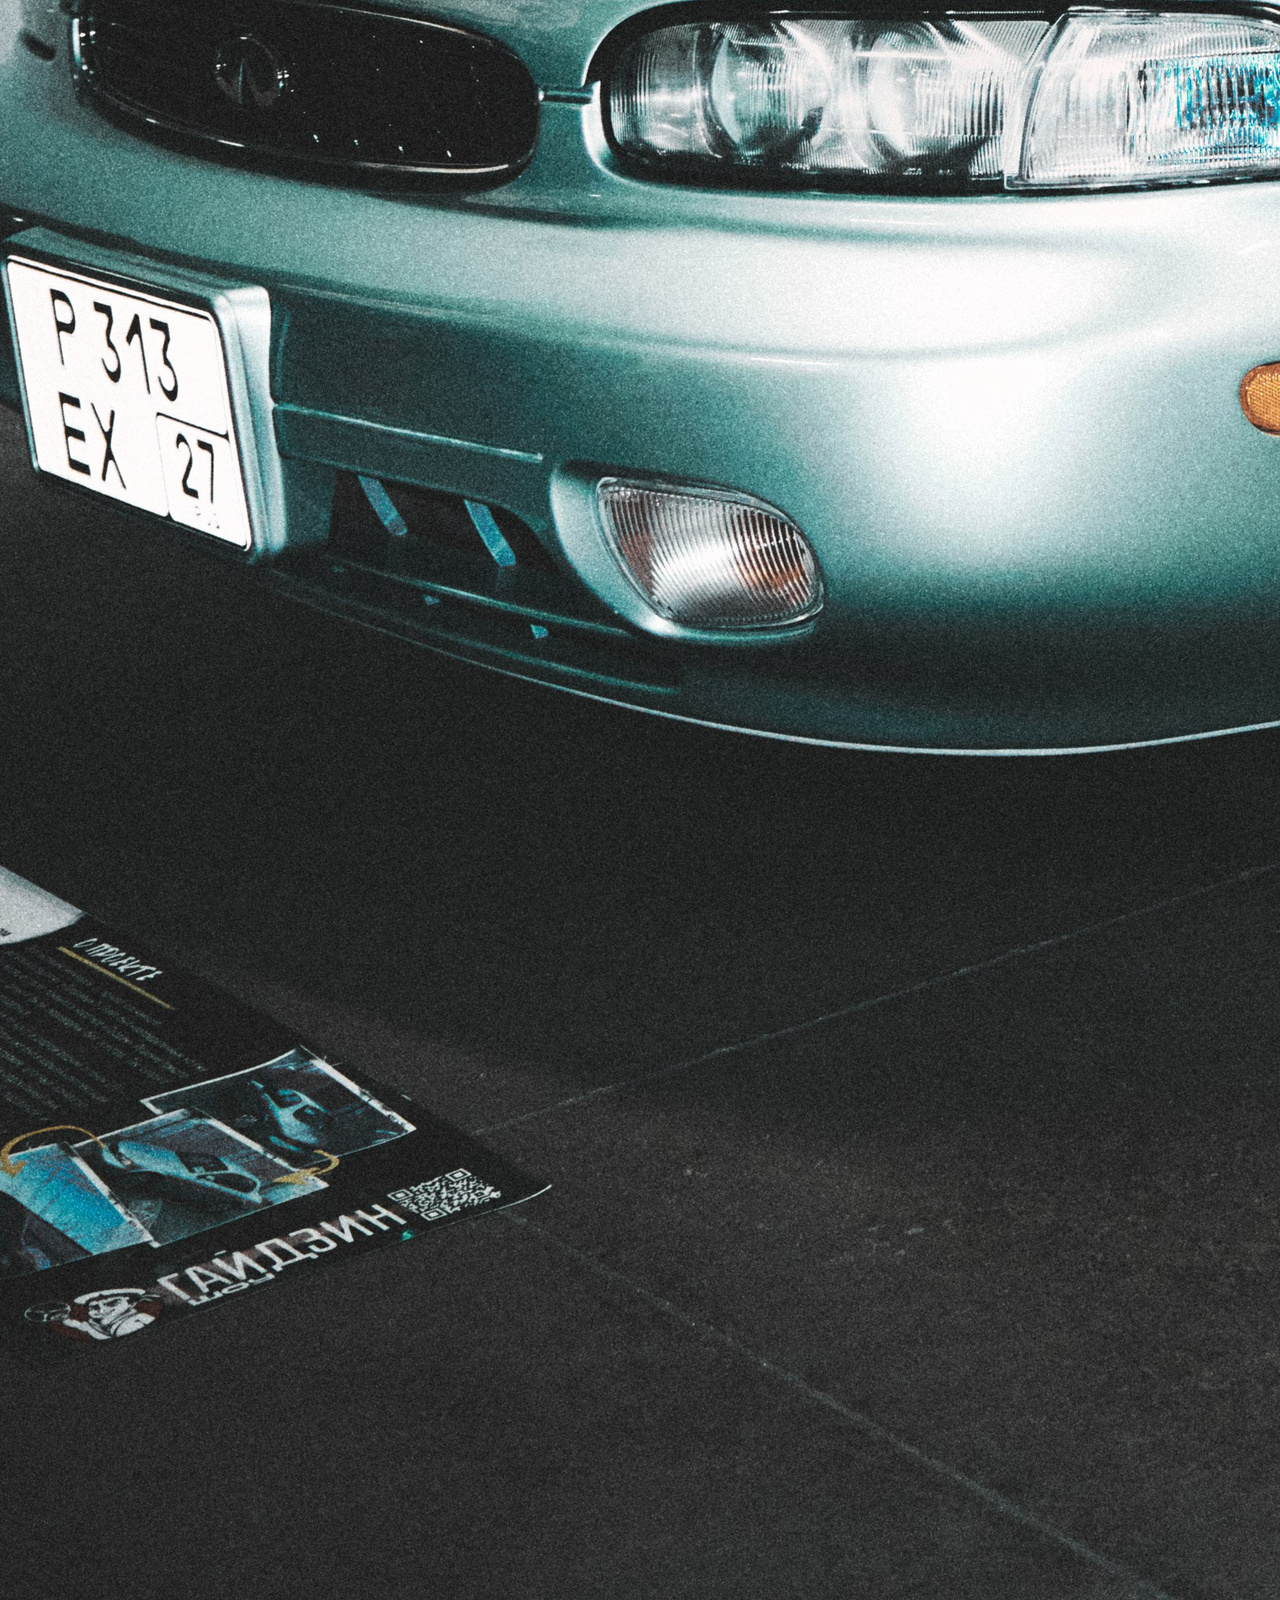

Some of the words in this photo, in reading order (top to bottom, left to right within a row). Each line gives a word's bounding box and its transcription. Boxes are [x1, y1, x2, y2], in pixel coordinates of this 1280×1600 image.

[93, 301, 179, 402] 313
[176, 433, 215, 504] 27
[85, 943, 163, 982] ПРОЕКТЕ
[157, 1203, 408, 1301] ГАЙДЗИН
